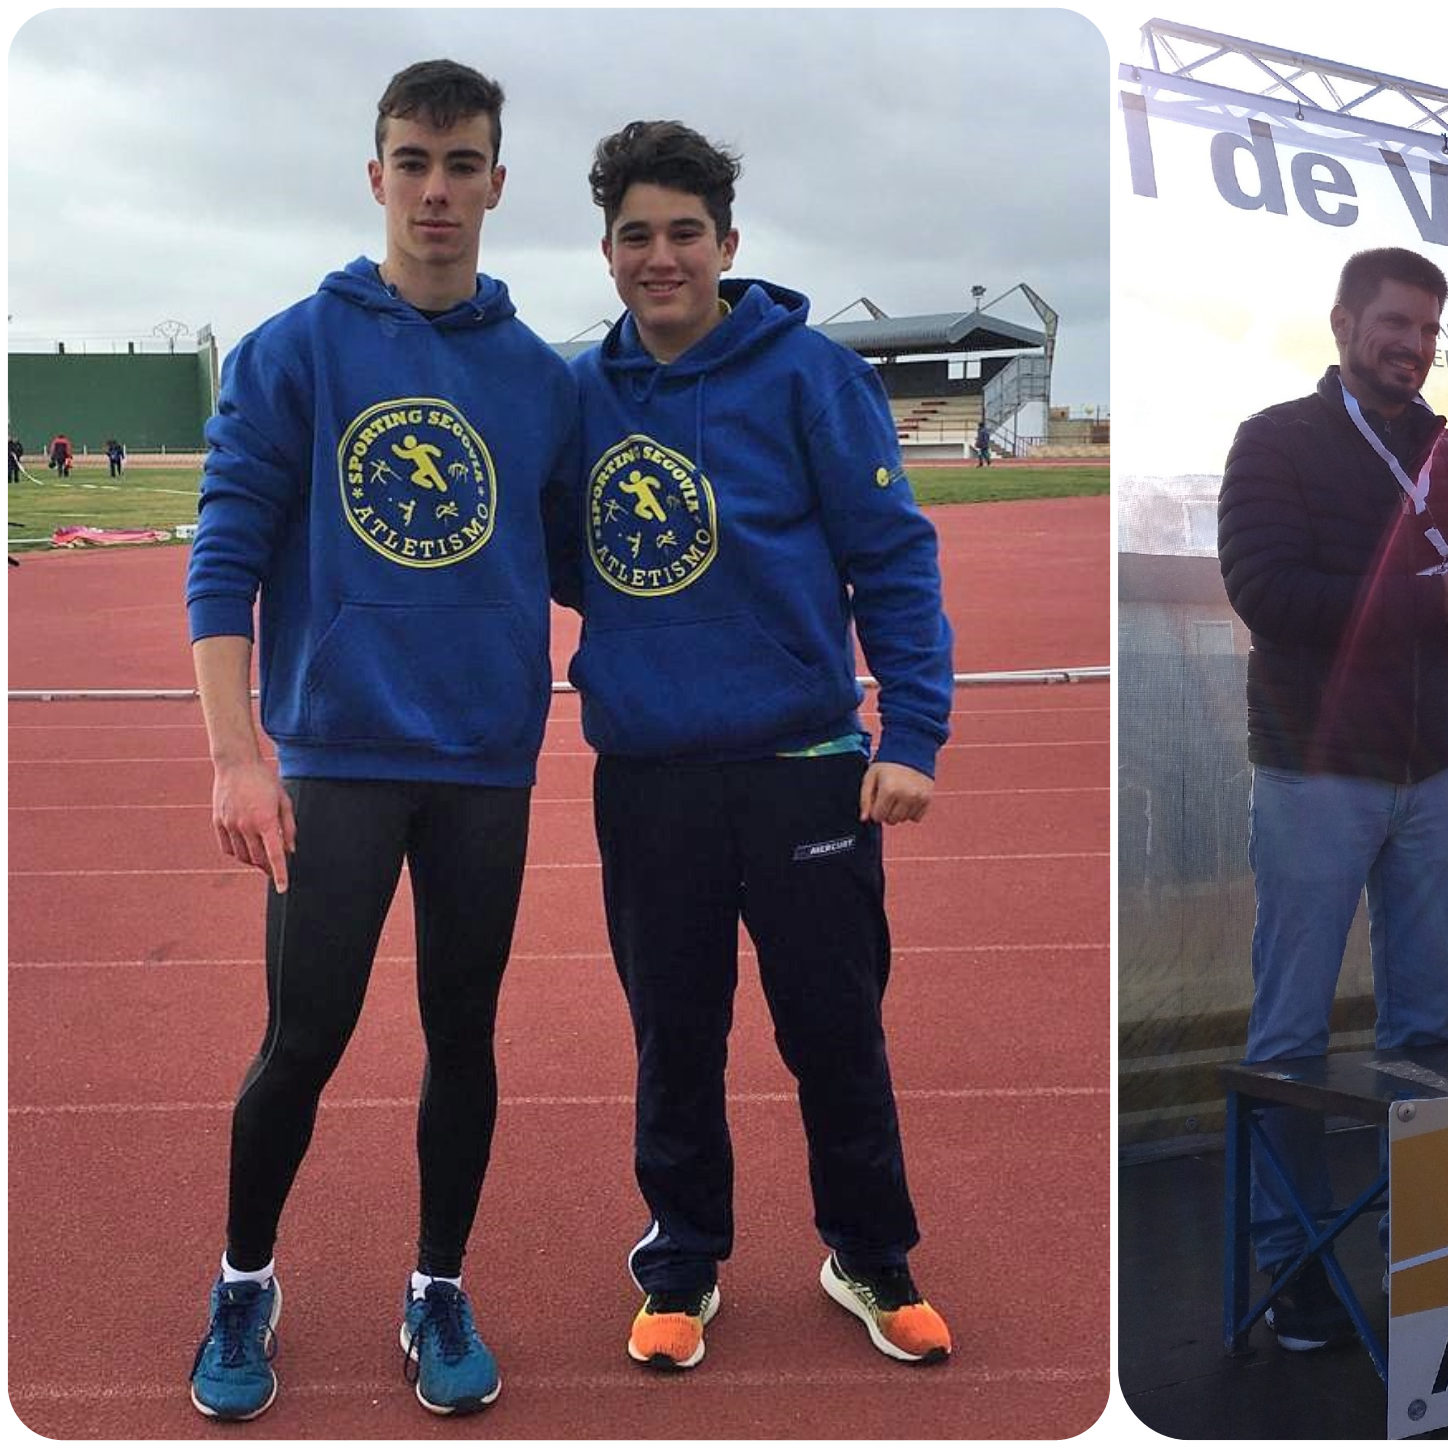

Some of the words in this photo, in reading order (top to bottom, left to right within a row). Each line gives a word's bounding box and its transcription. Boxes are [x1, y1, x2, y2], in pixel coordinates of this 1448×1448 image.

[1210, 118, 1359, 227] de
[348, 409, 422, 484] SPORTING
[428, 411, 484, 484] SEGOVIA
[354, 503, 488, 558] ATLETISMO
[597, 529, 711, 587] ATLETISMO
